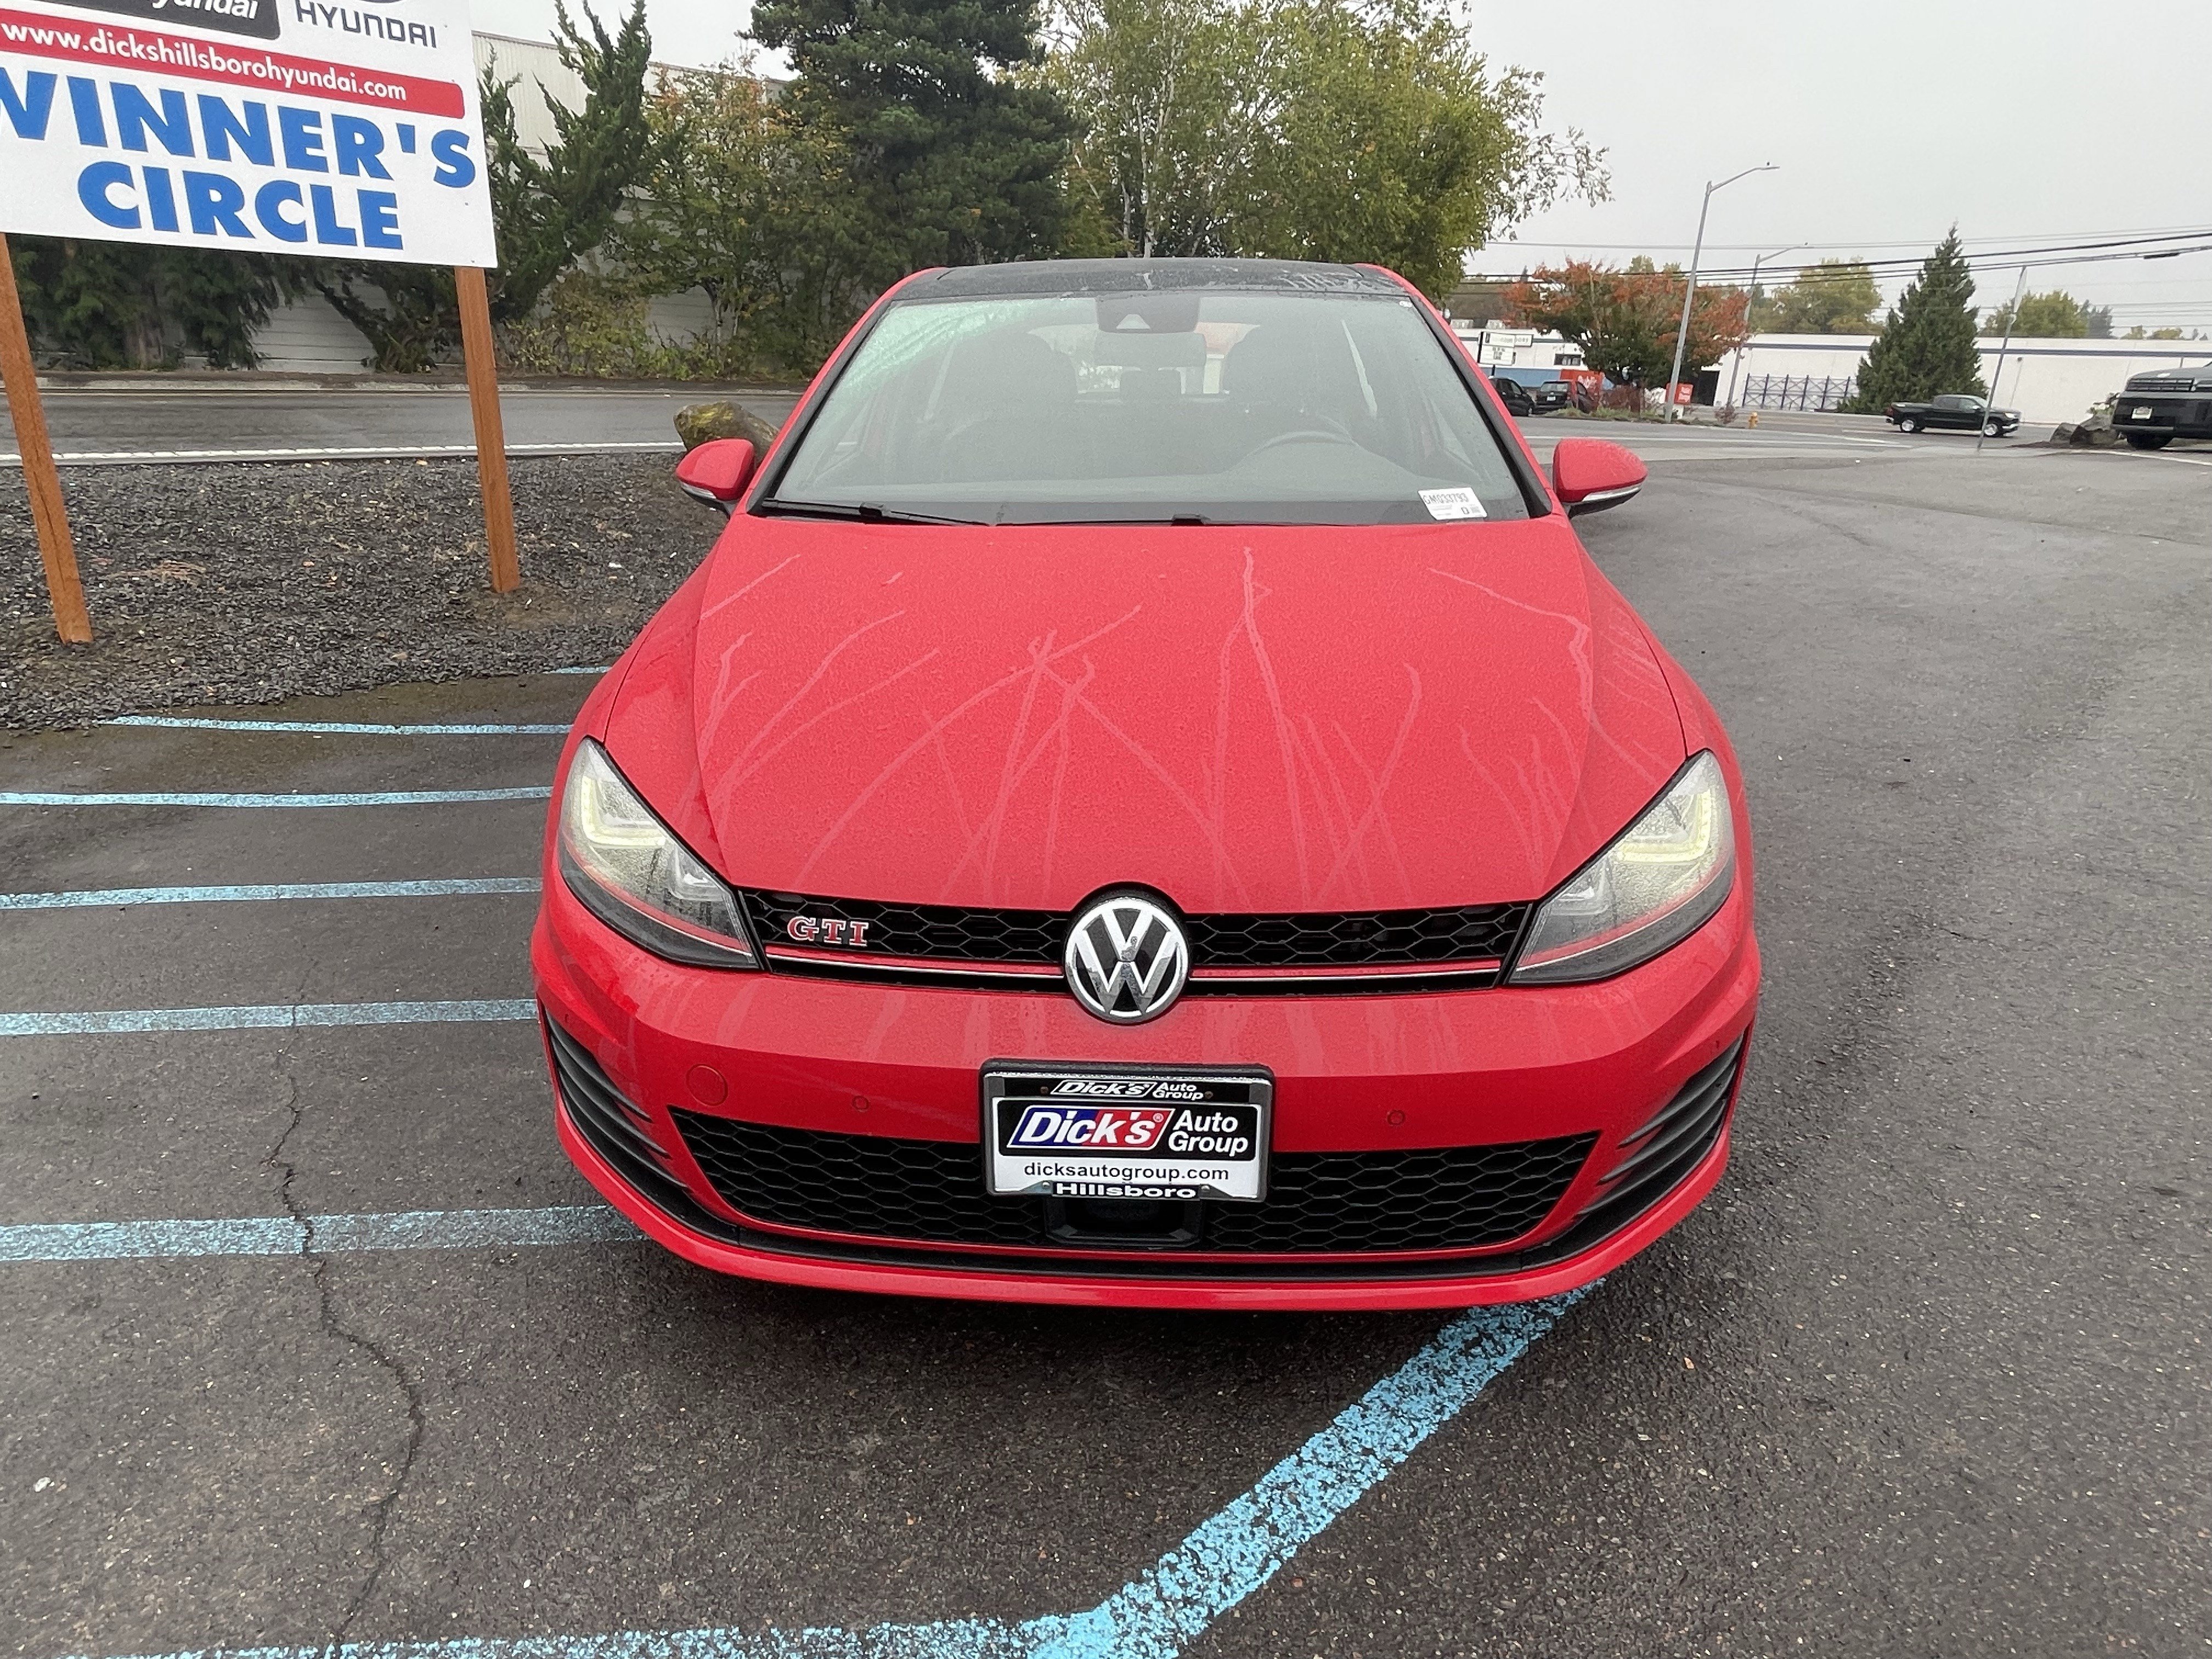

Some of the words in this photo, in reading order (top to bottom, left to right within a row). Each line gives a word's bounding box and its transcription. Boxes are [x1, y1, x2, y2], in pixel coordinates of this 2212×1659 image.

[295, 0, 437, 49] HYUNDAI
[1, 22, 407, 101] www.dickshillsborohyundai.com
[77, 161, 403, 249] CIRCLE
[787, 915, 869, 947] GTI
[1070, 903, 1182, 1016] VW
[1058, 1080, 1147, 1096] Dick's
[1152, 1090, 1204, 1101] Group
[1158, 1082, 1197, 1092] Auto
[1018, 1110, 1155, 1144] Dick's
[1172, 1110, 1238, 1133] Auto
[1168, 1131, 1249, 1157] Group
[1024, 1162, 1229, 1182] dicksautogroup.com
[1056, 1182, 1197, 1198] Hillsboro
